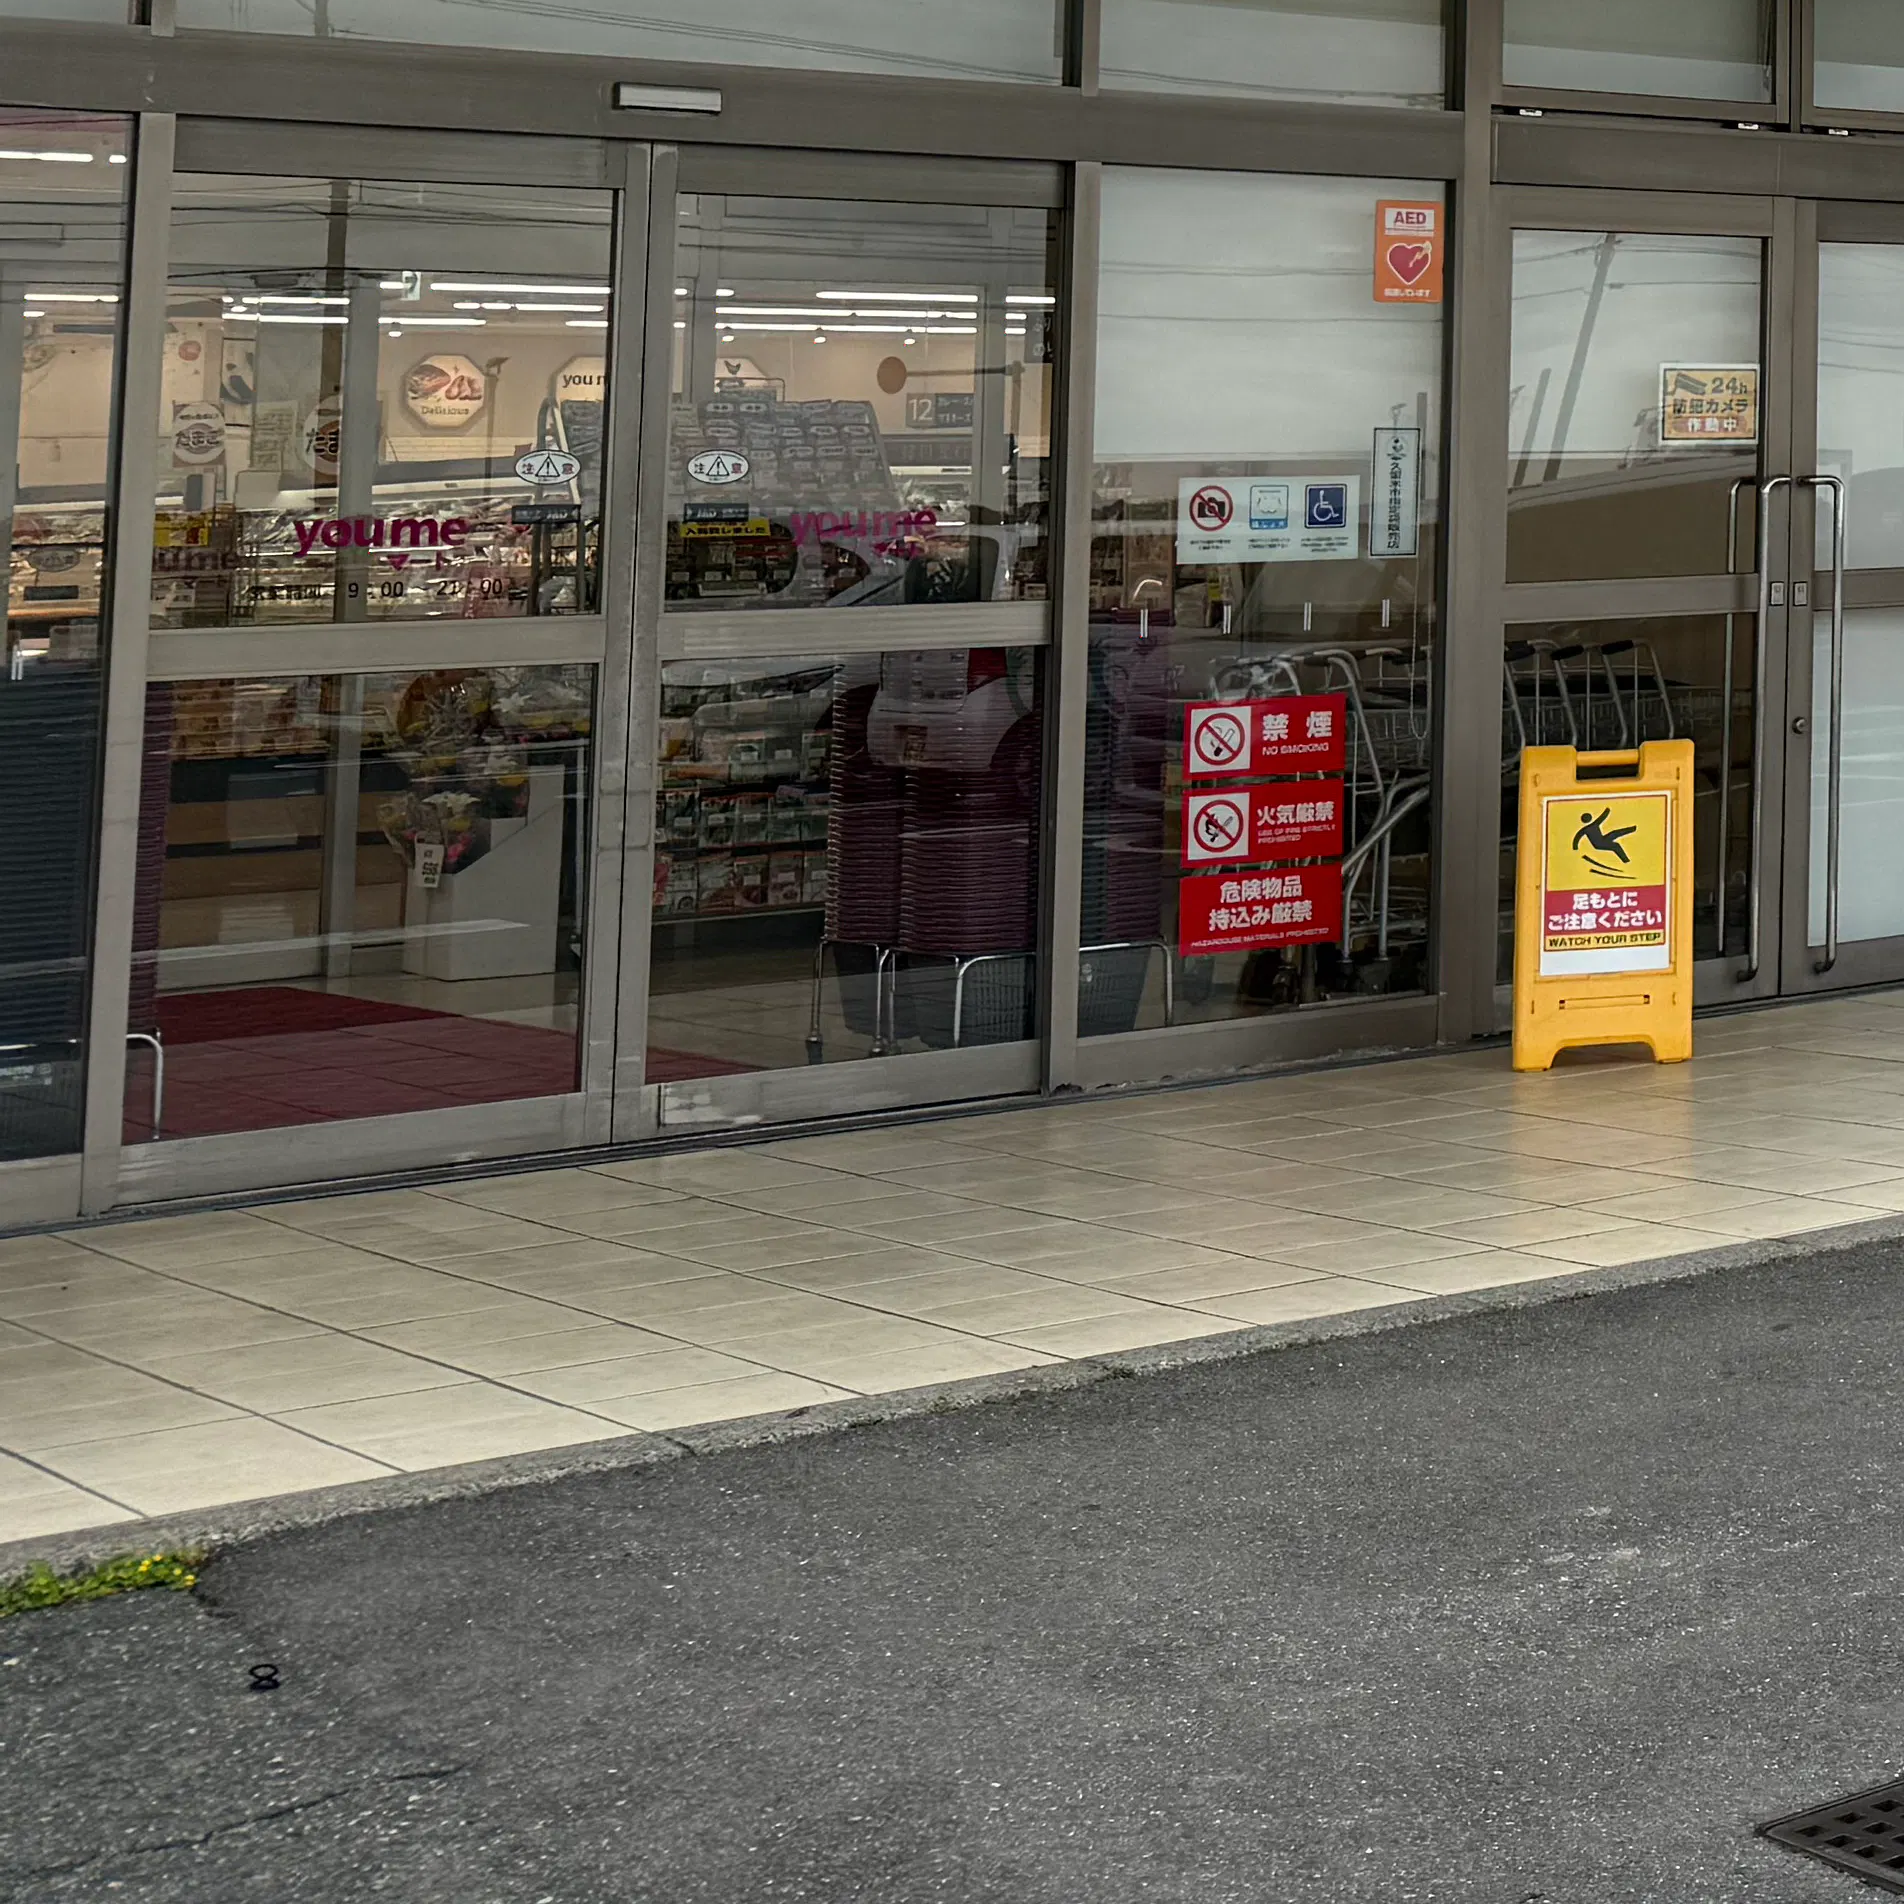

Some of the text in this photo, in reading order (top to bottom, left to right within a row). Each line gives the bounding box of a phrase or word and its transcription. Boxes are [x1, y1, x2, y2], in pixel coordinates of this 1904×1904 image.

[1393, 210, 1427, 225] AED
[1711, 377, 1748, 395] 24h
[908, 399, 933, 421] 12
[1673, 398, 1748, 414] 防犯カメラ
[293, 516, 470, 558] youme
[790, 506, 938, 547] youme
[1262, 710, 1333, 742] 禁煙
[1262, 742, 1330, 756] NO SMOKING
[1256, 801, 1335, 827] 火気厳禁
[1219, 874, 1303, 904] 危険物品
[1572, 891, 1638, 911] 足もとに
[1208, 899, 1313, 932] 持込み厳禁
[1548, 909, 1662, 931] ご注意ください
[1549, 931, 1661, 947] WATCH YOUR STEP
